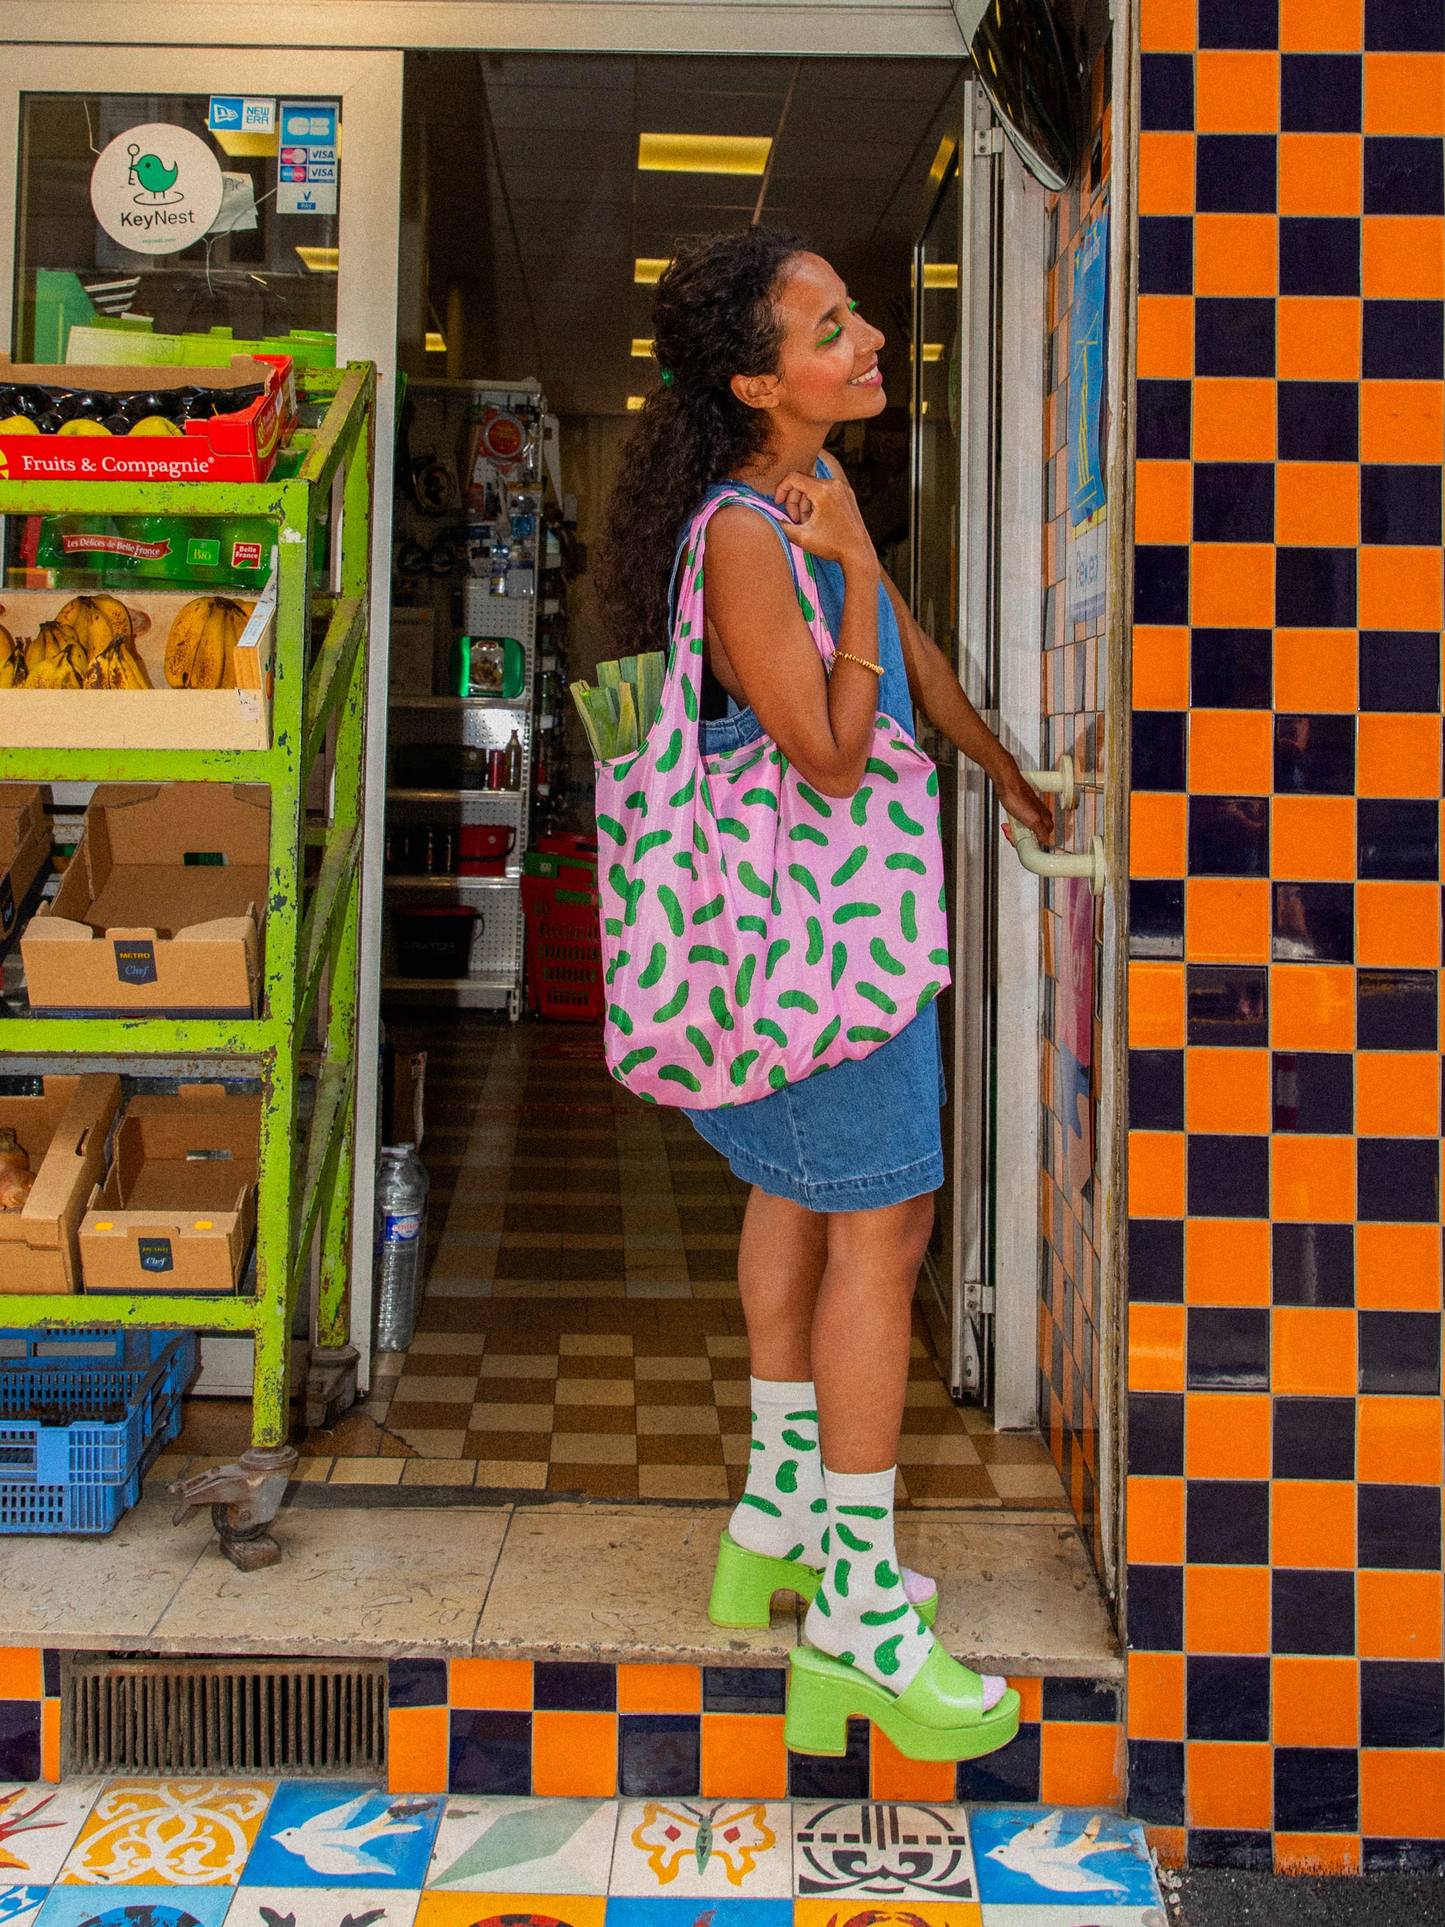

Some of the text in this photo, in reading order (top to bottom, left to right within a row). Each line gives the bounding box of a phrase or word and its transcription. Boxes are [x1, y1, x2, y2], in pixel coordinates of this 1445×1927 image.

[246, 106, 270, 116] NEW
[246, 115, 269, 125] ERA
[312, 150, 335, 159] VISA
[311, 168, 334, 177] VISA
[120, 210, 196, 230] KeyNest
[22, 455, 76, 472] Fruits
[81, 457, 97, 472] &
[67, 538, 160, 555] Les Délices de Belle France
[239, 545, 257, 553] Belle
[235, 551, 259, 559] France
[125, 965, 150, 977] Chef
